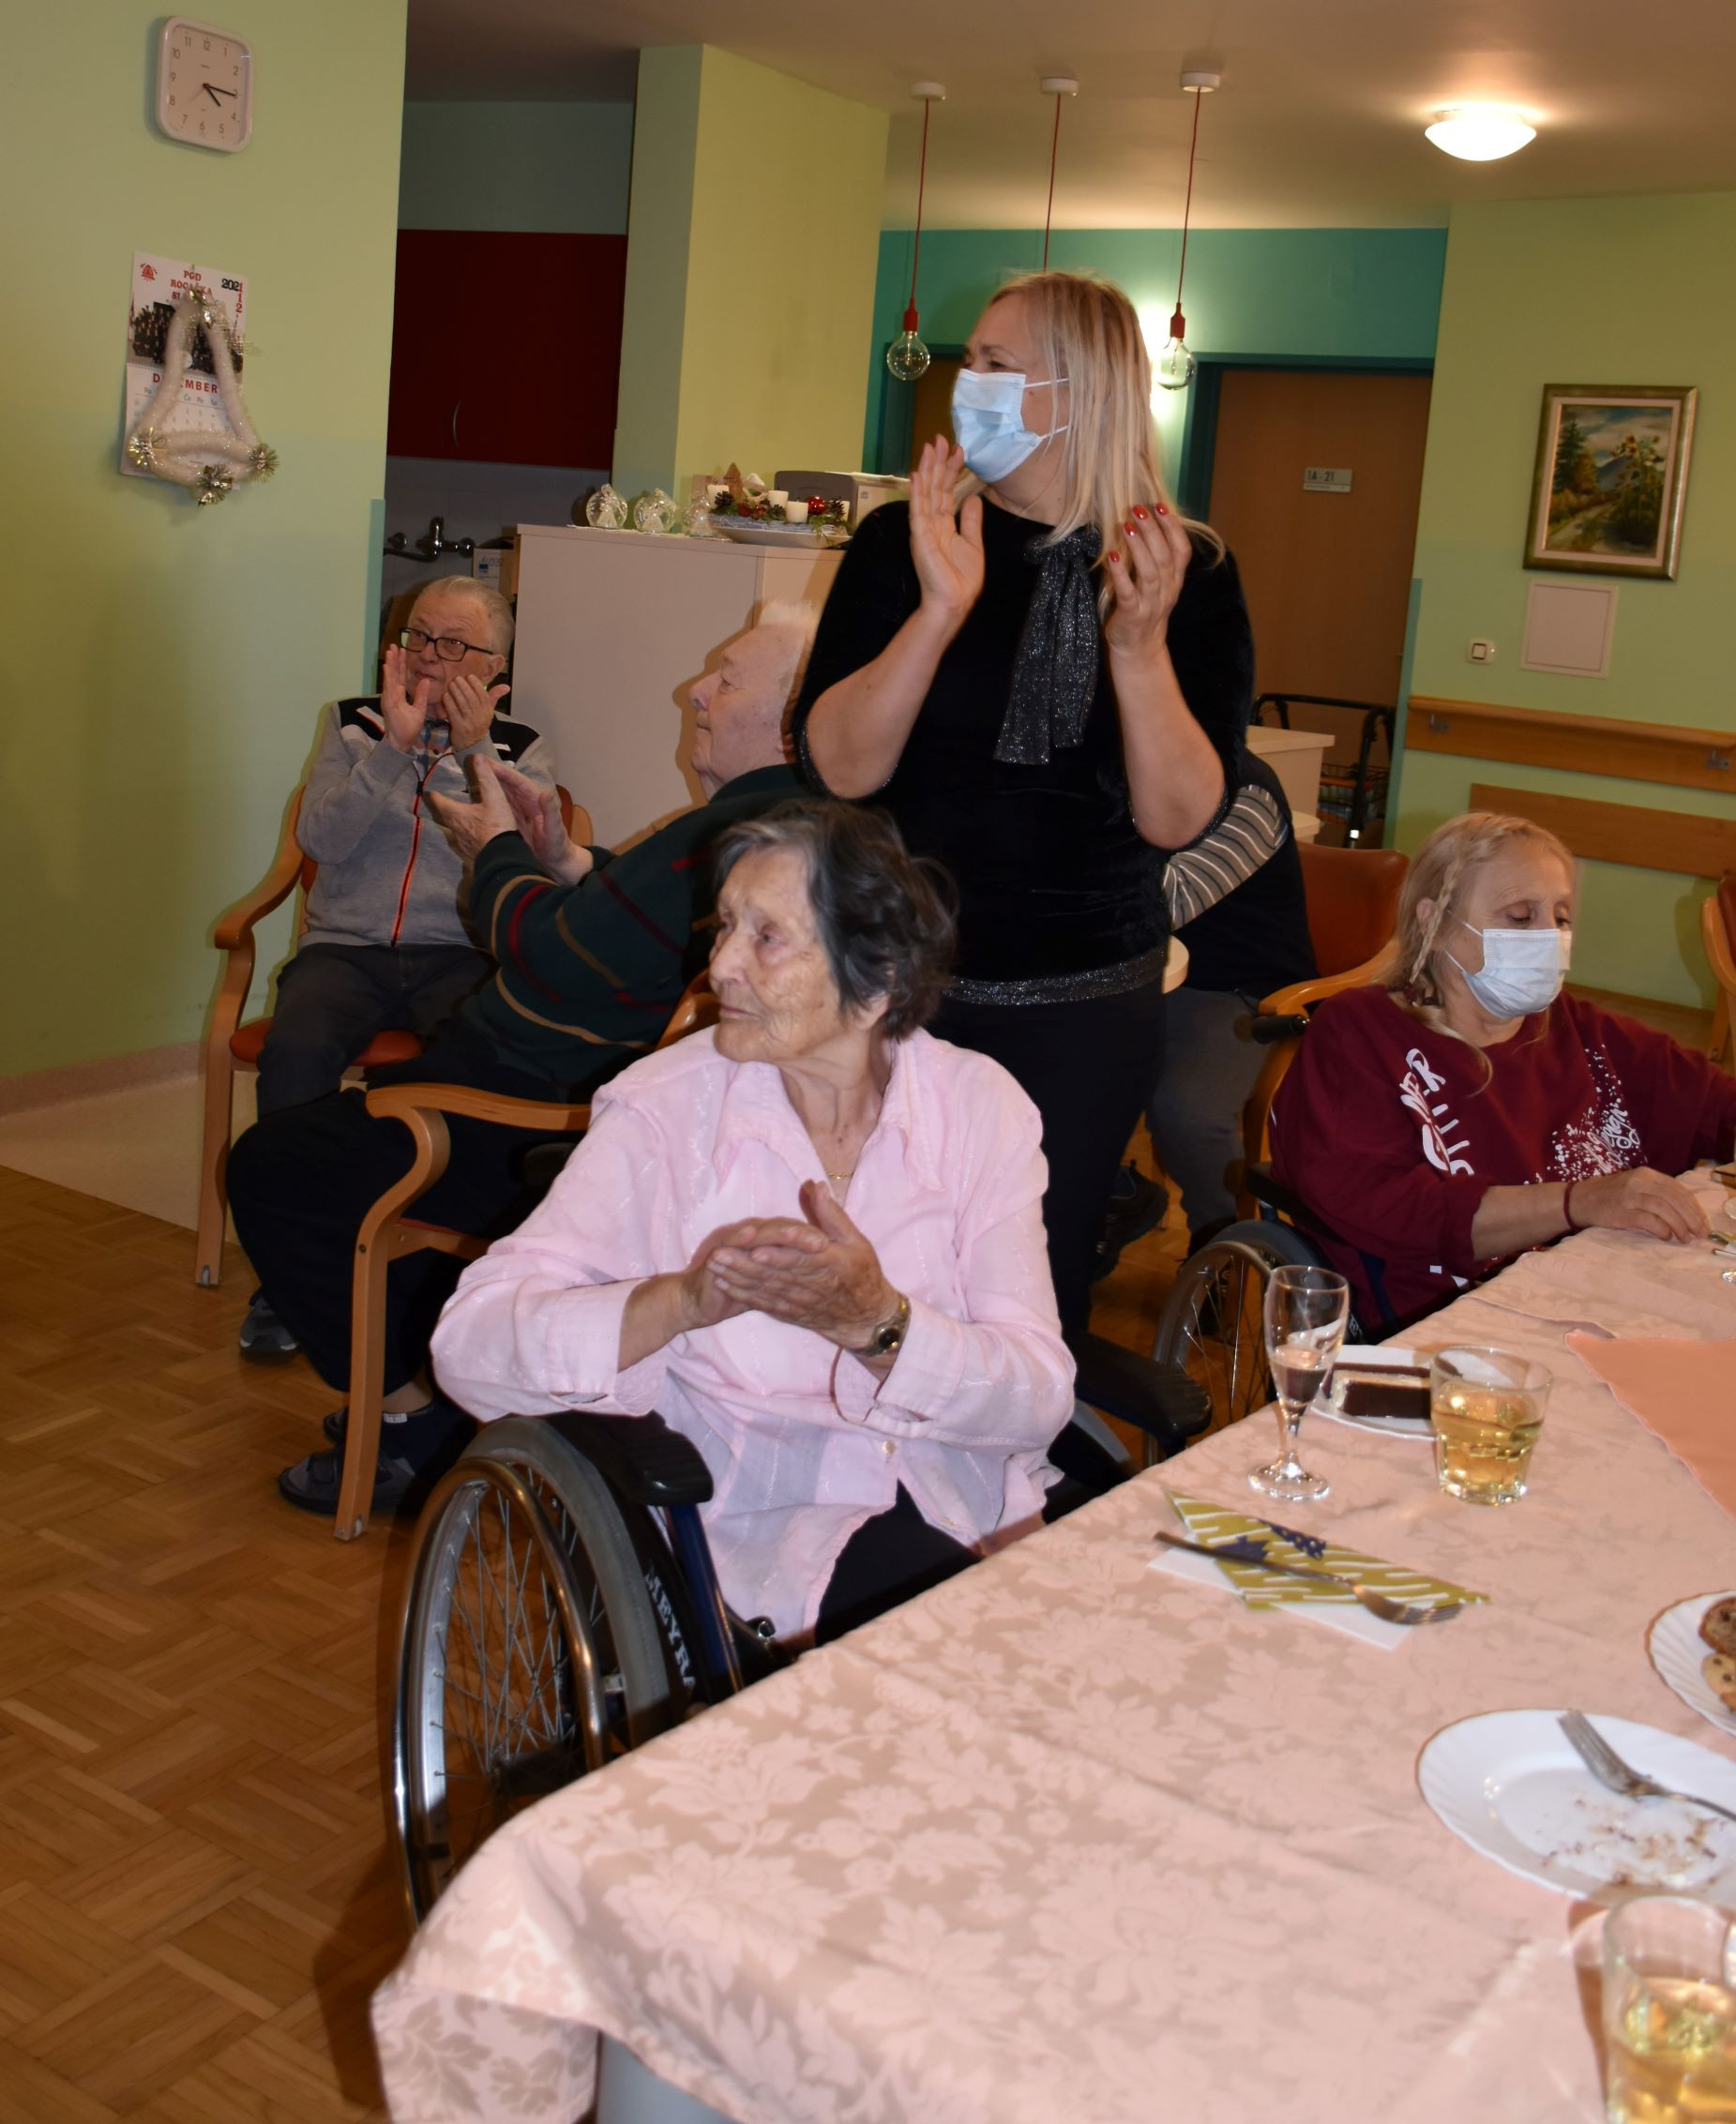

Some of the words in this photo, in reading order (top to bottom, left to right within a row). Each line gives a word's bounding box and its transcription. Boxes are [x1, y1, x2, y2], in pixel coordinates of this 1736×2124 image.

[204, 39, 211, 51] 12
[173, 48, 180, 58] 10
[234, 66, 238, 75] 2
[171, 72, 175, 82] 9
[170, 96, 175, 105] 8
[183, 114, 188, 124] 7
[231, 113, 236, 121] 4
[200, 121, 205, 130] 6
[219, 124, 224, 133] 5
